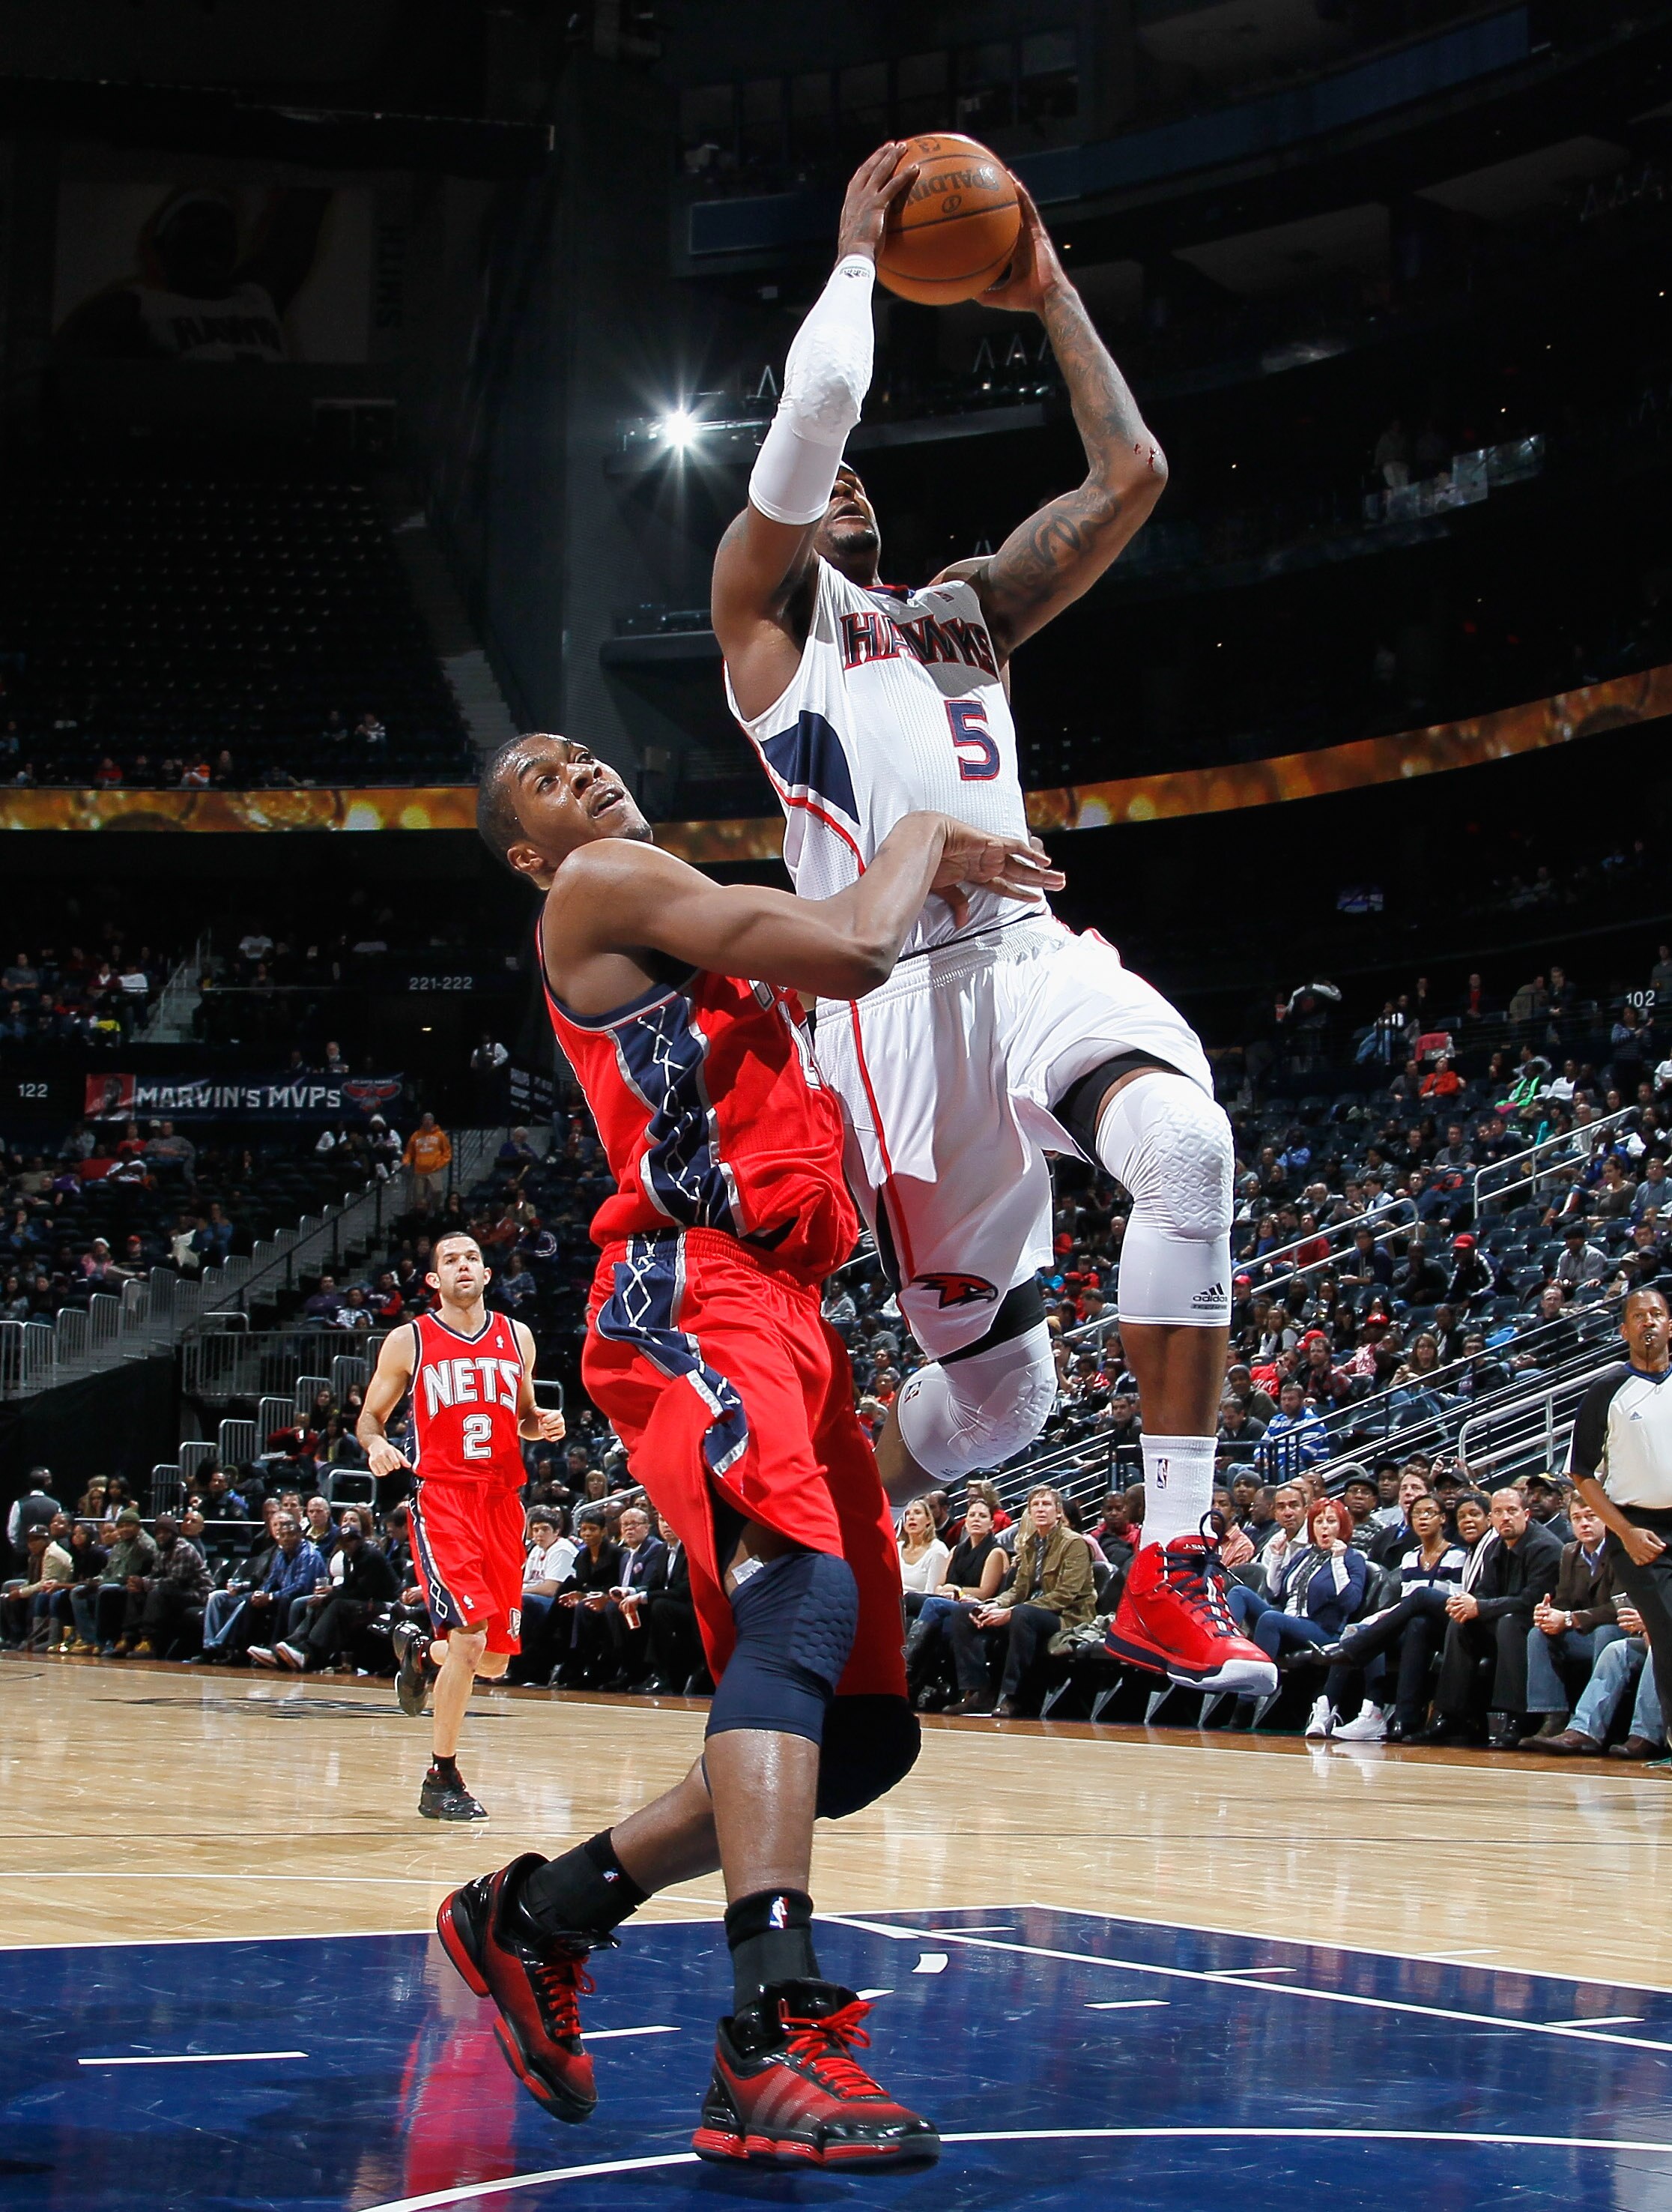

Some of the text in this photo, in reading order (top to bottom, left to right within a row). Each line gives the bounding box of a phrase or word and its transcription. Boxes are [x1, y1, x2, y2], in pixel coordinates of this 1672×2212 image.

[907, 166, 1000, 205] SPALDIN
[840, 611, 1000, 679] HAWKS
[944, 700, 1000, 781] 5
[409, 976, 473, 990] 221-222
[1626, 990, 1656, 1008] 102
[19, 1084, 48, 1097] 122
[422, 1357, 522, 1420] NETS
[462, 1414, 492, 1460] 2
